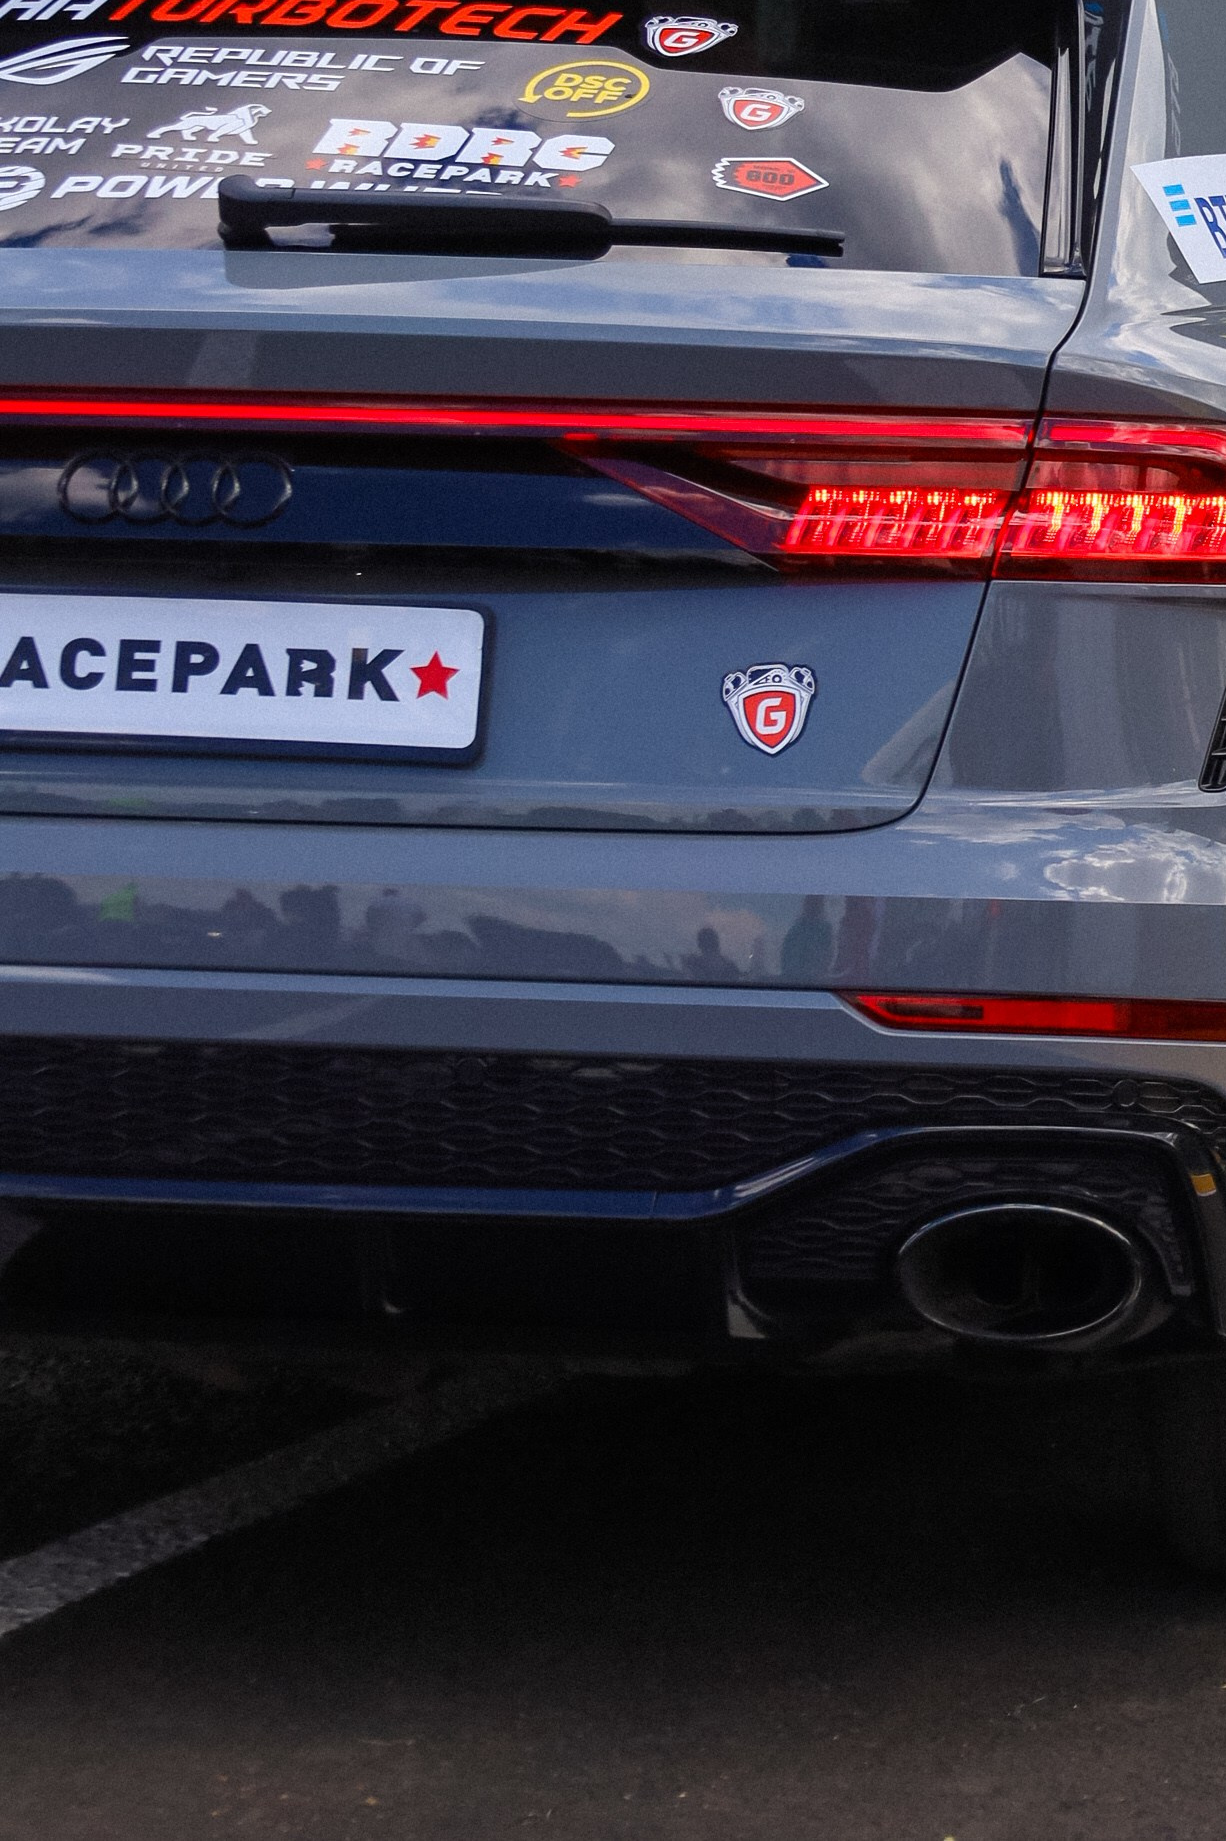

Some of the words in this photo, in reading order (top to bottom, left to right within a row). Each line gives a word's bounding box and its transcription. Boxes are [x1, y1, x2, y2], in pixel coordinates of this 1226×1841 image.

[141, 45, 405, 72] REPUBLIC
[408, 55, 487, 76] OF
[119, 67, 346, 92] GAMERS
[553, 72, 632, 92] DSC
[543, 85, 624, 104] OFF
[111, 143, 274, 168] PRIDE
[312, 119, 616, 171] RDRC
[140, 162, 224, 173] UNITED
[327, 159, 558, 189] RACEPARK
[0, 636, 405, 702] ACEPARK
